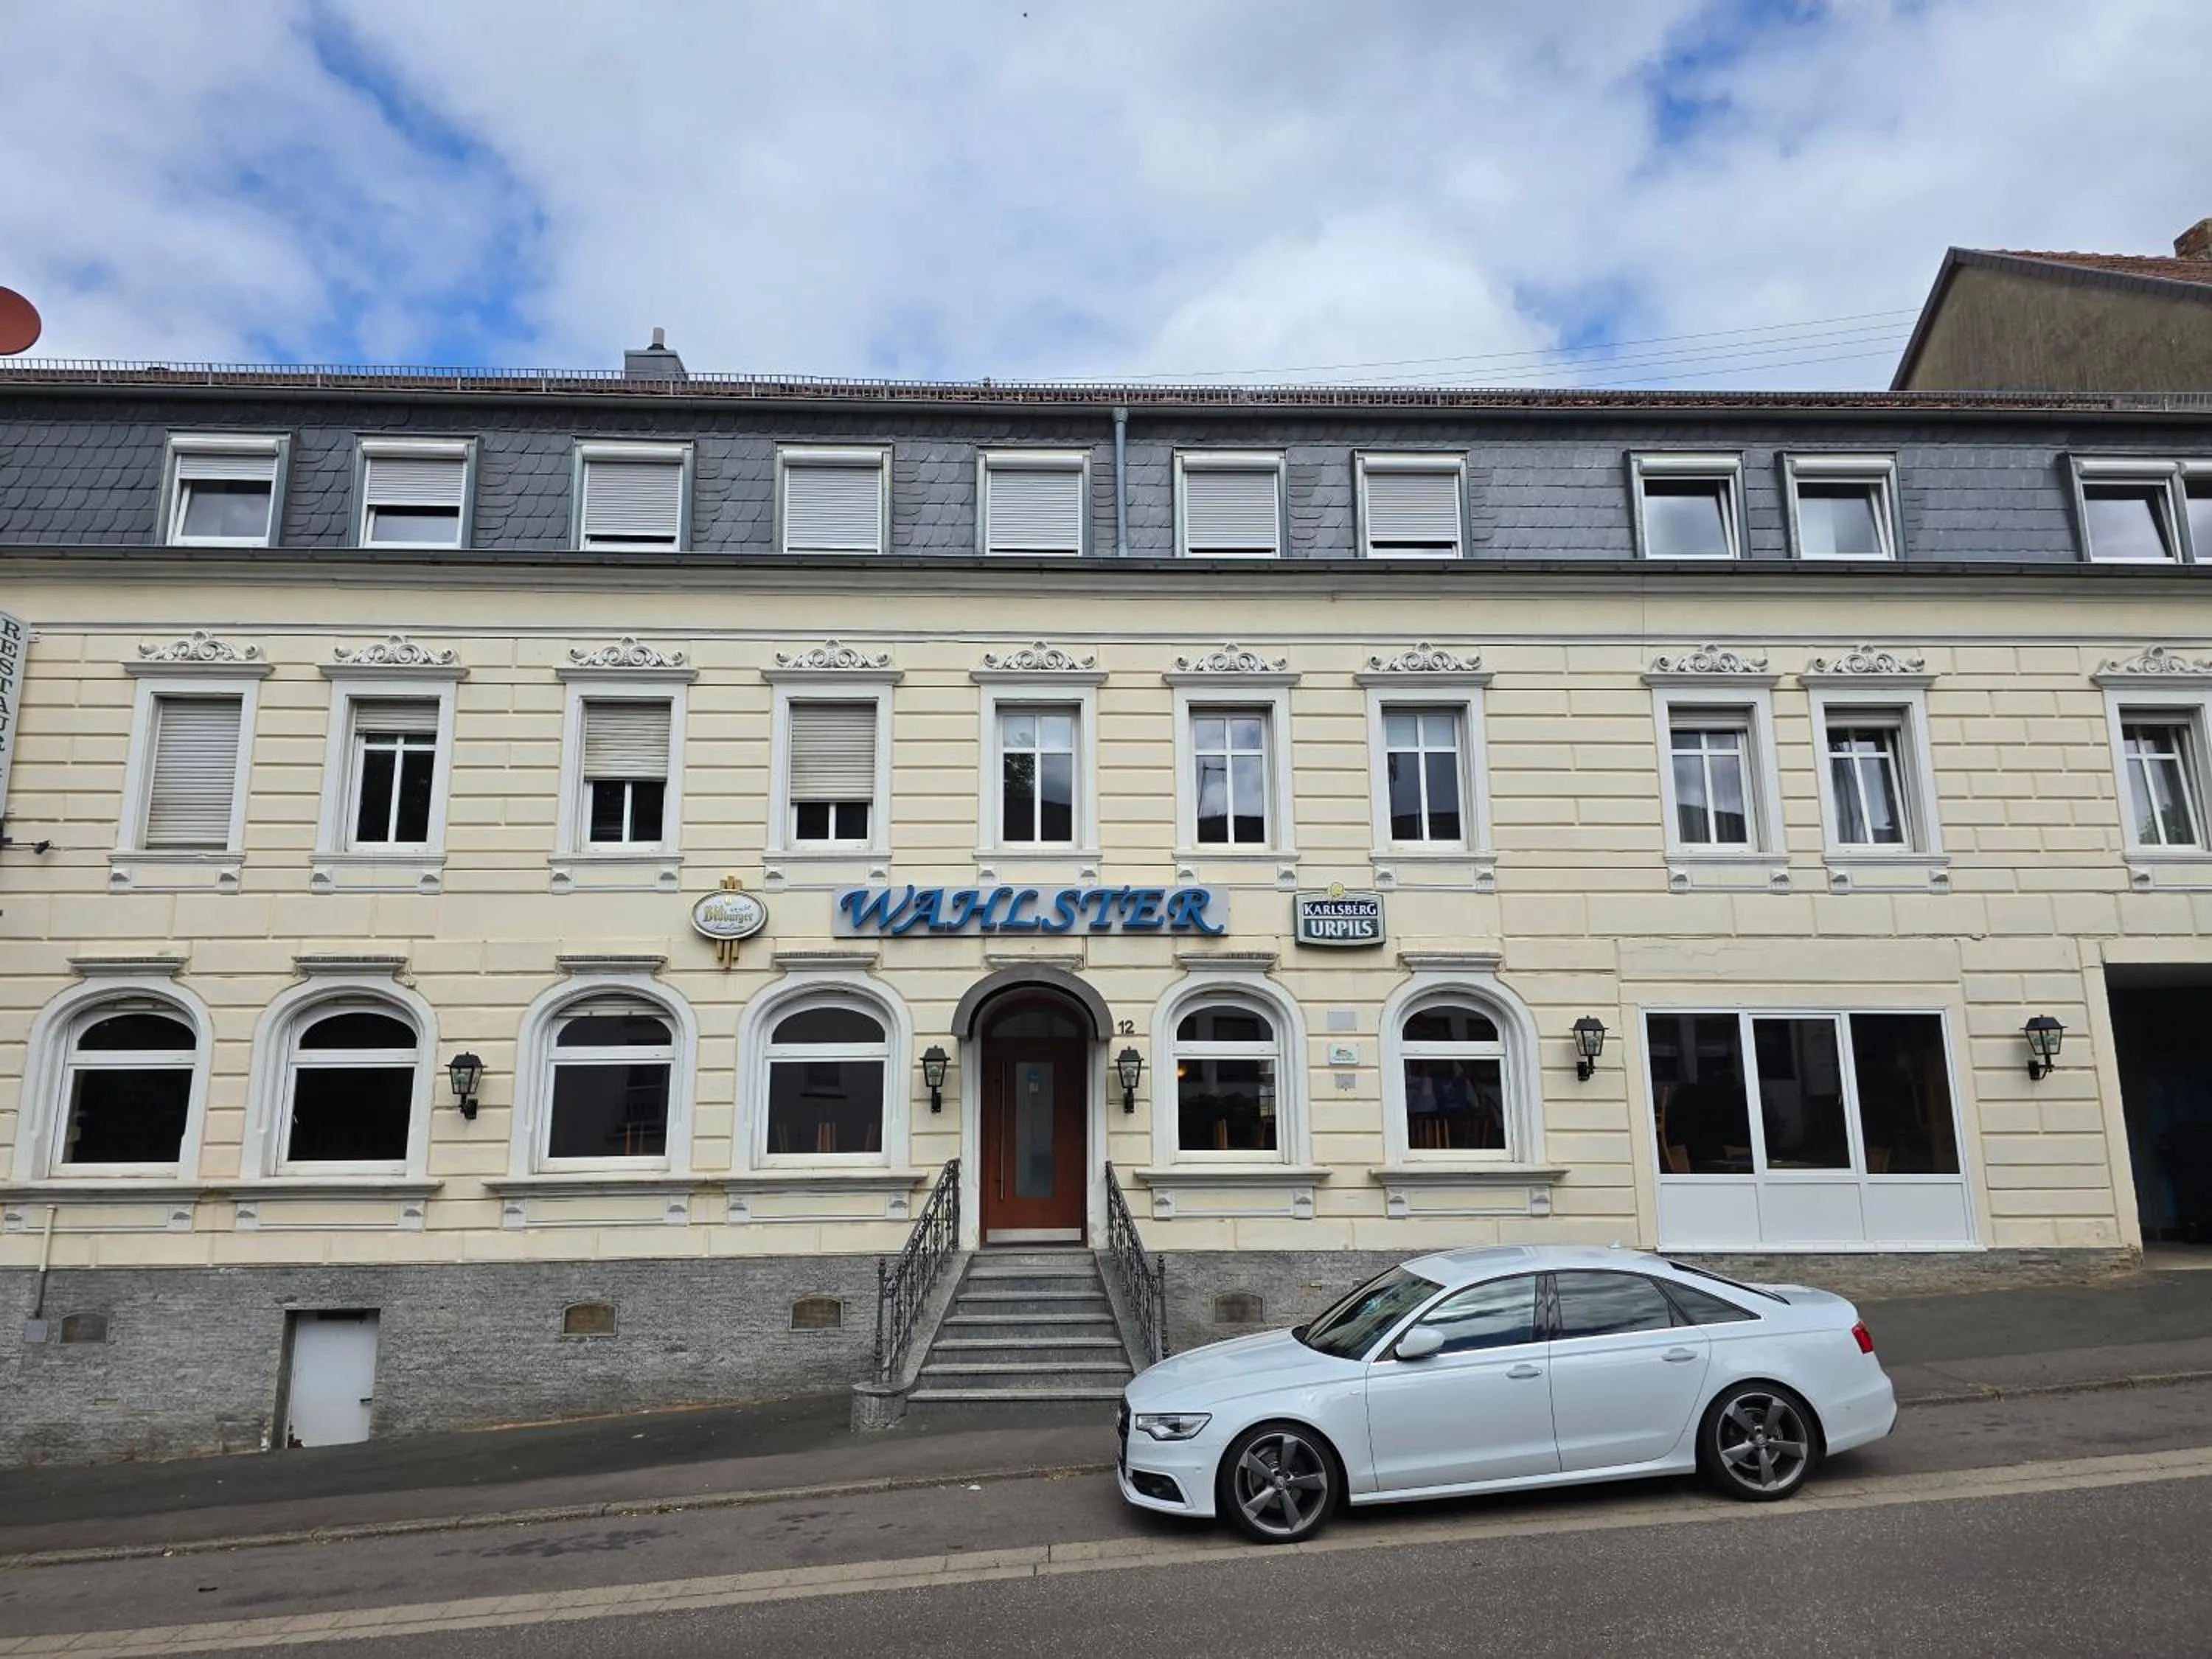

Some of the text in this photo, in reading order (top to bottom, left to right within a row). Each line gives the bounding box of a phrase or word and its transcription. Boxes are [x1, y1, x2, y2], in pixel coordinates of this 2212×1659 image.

[840, 885, 1224, 934] WAHLSTER
[1304, 903, 1377, 916] KARLSBERG
[1310, 919, 1373, 936] URPILS
[1118, 1020, 1135, 1034] 12
